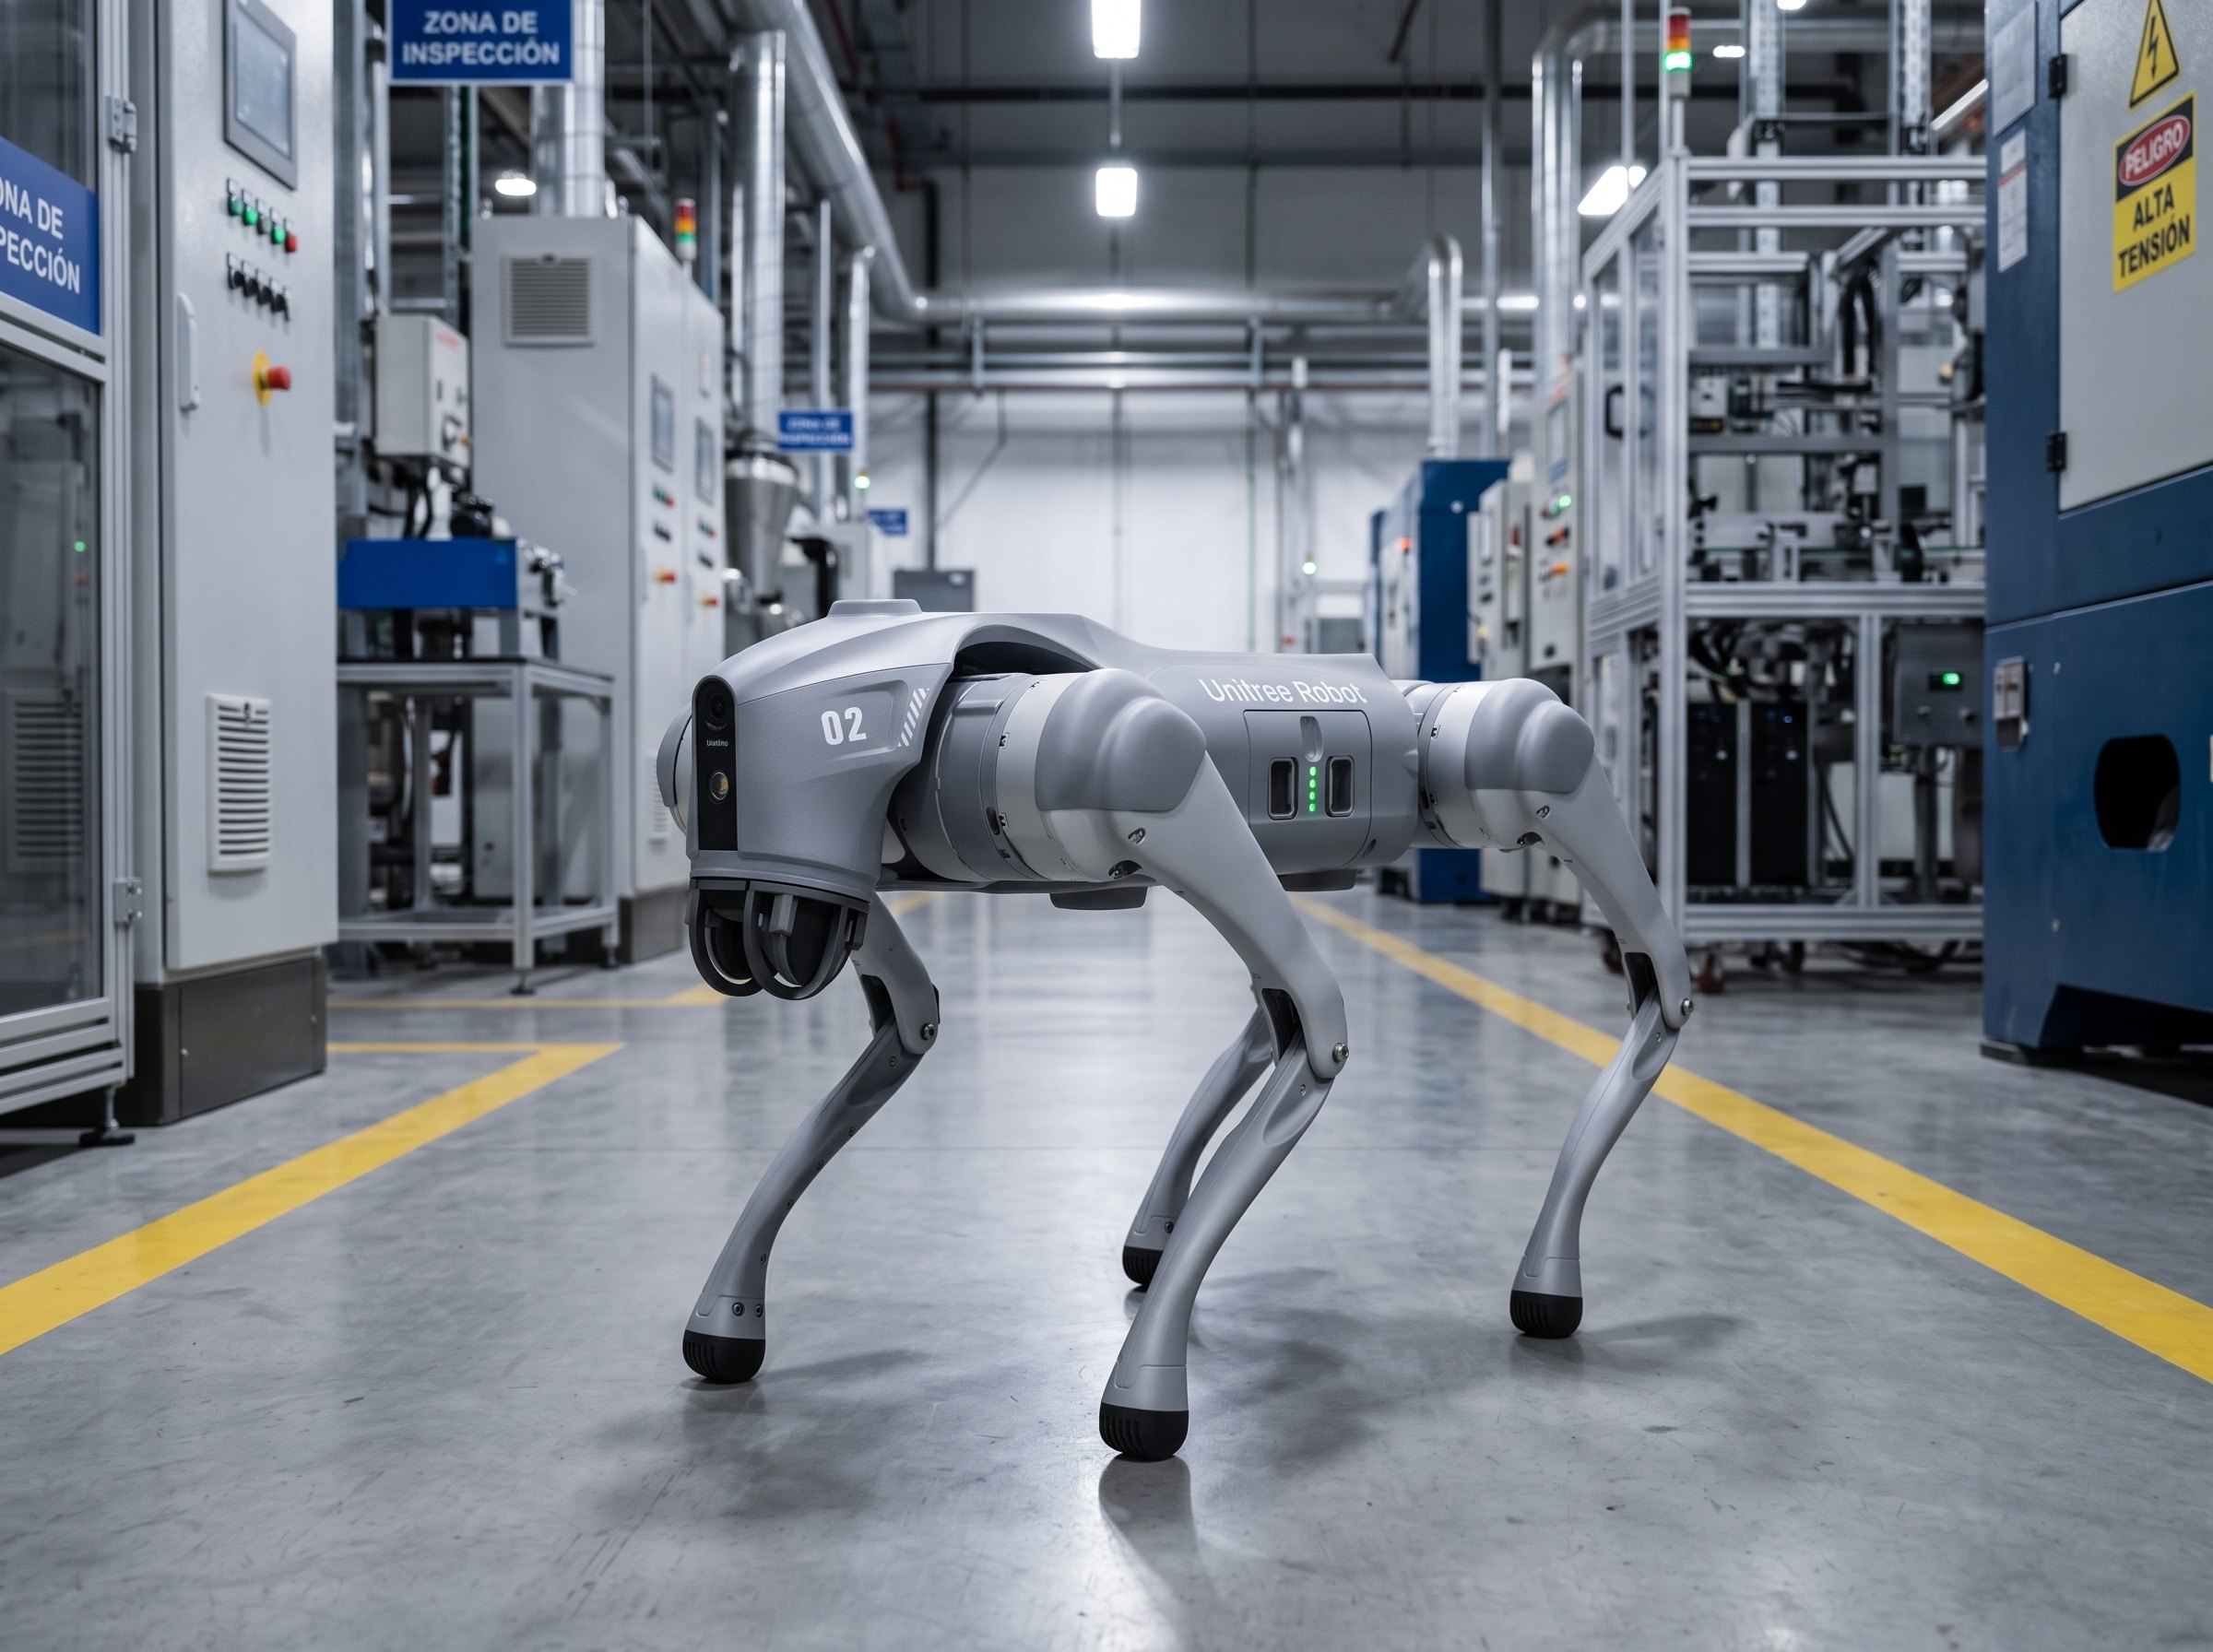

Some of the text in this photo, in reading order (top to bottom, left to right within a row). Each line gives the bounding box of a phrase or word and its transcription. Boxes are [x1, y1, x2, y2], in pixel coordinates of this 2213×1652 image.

[422, 10, 538, 34] ZONA DE
[402, 37, 560, 65] INSPECCIÓN
[2124, 121, 2184, 181] PELIGRO
[38, 197, 64, 240] DE
[2133, 183, 2175, 231] ALTA
[2118, 212, 2191, 278] TENSIÓN
[1198, 678, 1368, 703] Unitree Robot
[821, 706, 867, 746] 02
